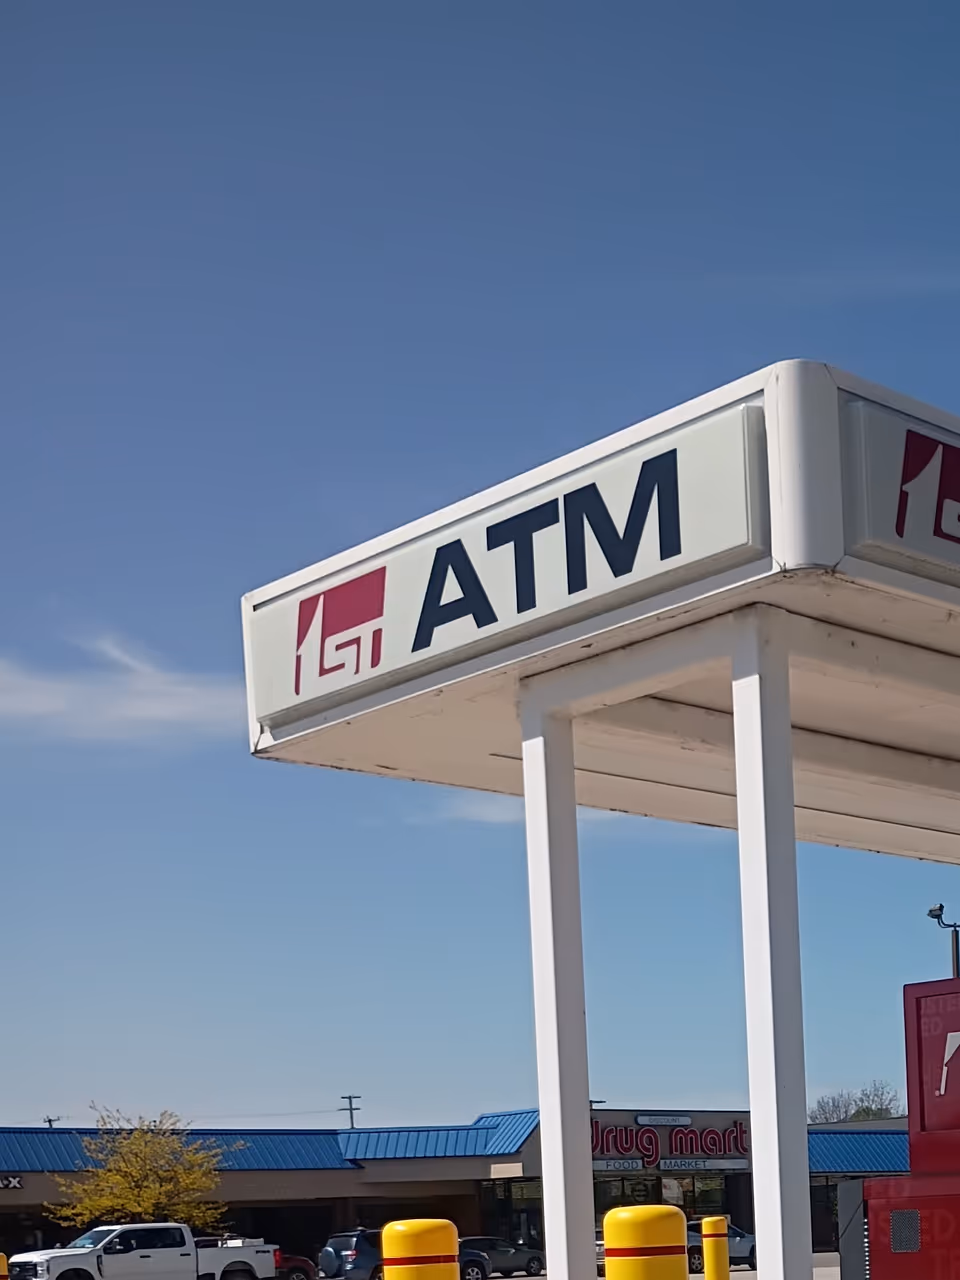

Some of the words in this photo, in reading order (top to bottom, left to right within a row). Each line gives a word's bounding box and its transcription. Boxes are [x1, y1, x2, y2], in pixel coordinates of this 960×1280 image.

[412, 448, 682, 652] ATM
[670, 1121, 749, 1155] mart
[605, 1160, 639, 1169] FOOD
[663, 1159, 708, 1169] MARKET
